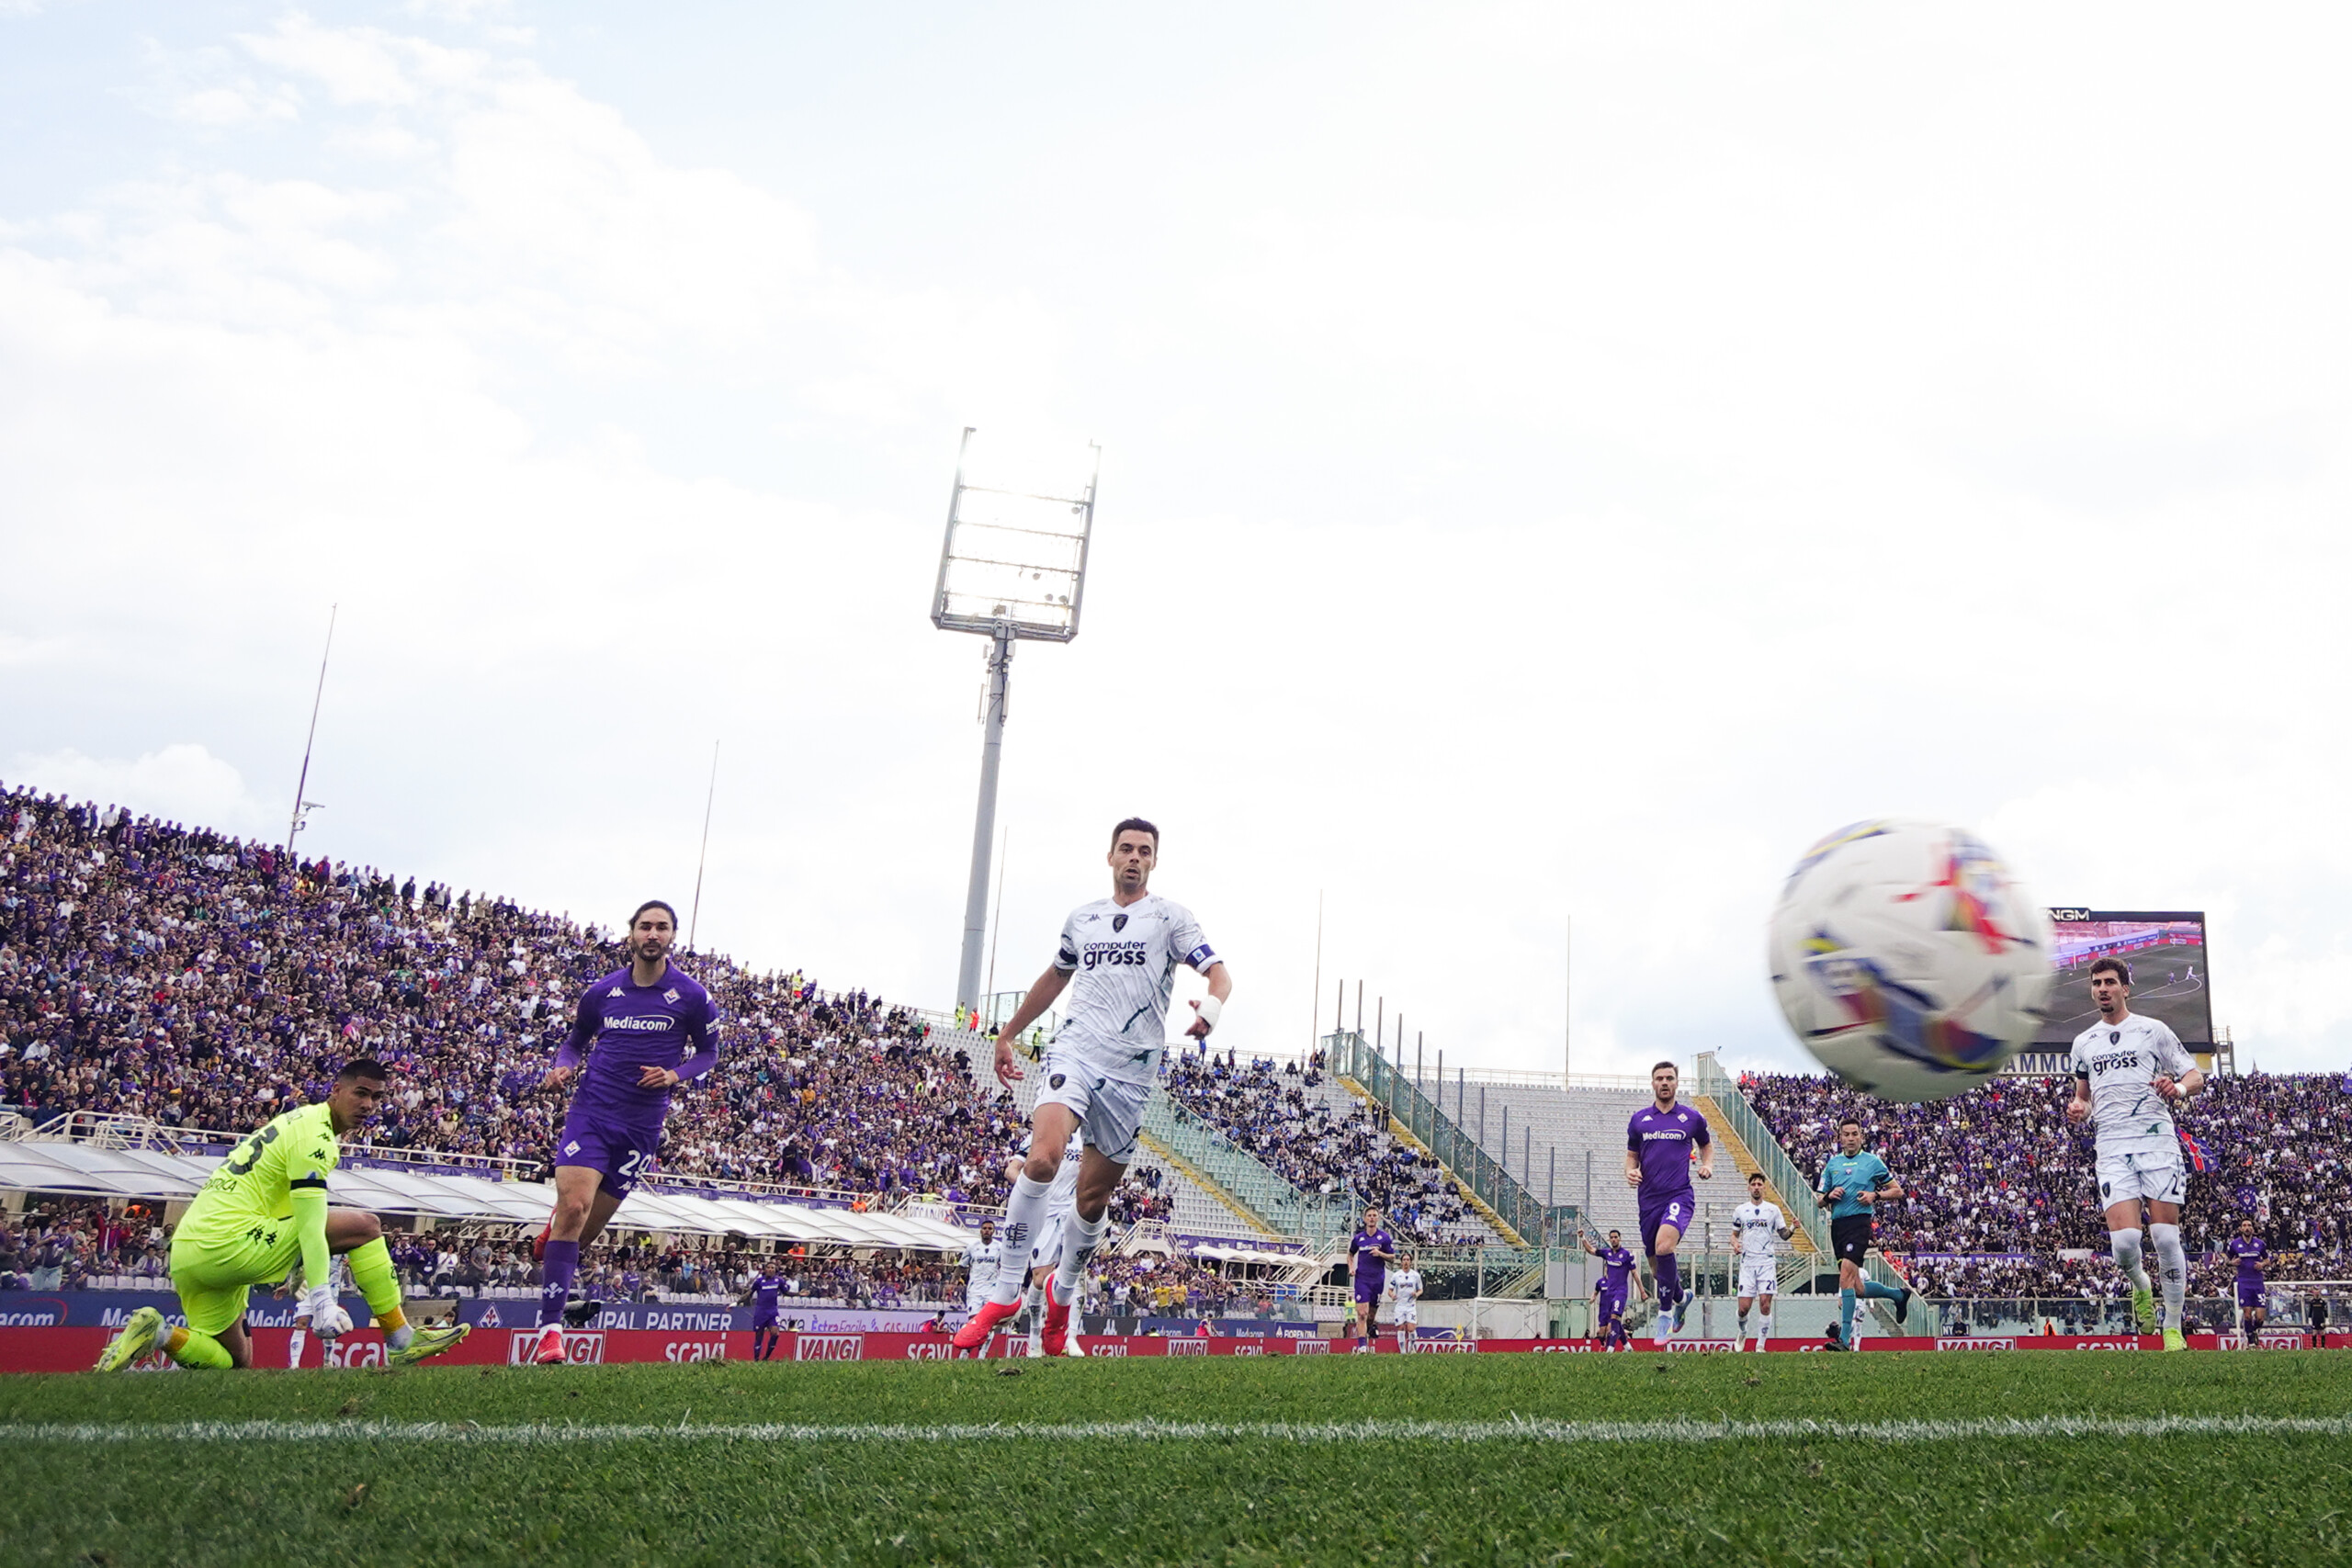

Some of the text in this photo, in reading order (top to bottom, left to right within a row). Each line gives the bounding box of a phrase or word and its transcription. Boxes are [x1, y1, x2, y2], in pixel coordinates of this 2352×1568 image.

[1083, 941, 1147, 952] computer
[1083, 950, 1146, 971] gross
[604, 1016, 668, 1032] Mediacom
[2091, 1050, 2137, 1061] computer
[2093, 1056, 2138, 1076] gross
[1642, 1130, 1682, 1141] Mediacom
[617, 1149, 652, 1179] 29
[1668, 1202, 1680, 1216] 9
[1766, 1280, 1776, 1291] 21
[646, 1312, 732, 1332] PARTNER
[665, 1333, 727, 1362] scavi
[801, 1338, 860, 1360] VANGI
[907, 1335, 954, 1360] scavi
[1091, 1337, 1128, 1357] scavi
[1170, 1341, 1207, 1356] VANGI
[1235, 1338, 1263, 1356] scavi
[1298, 1341, 1329, 1355] VANGI
